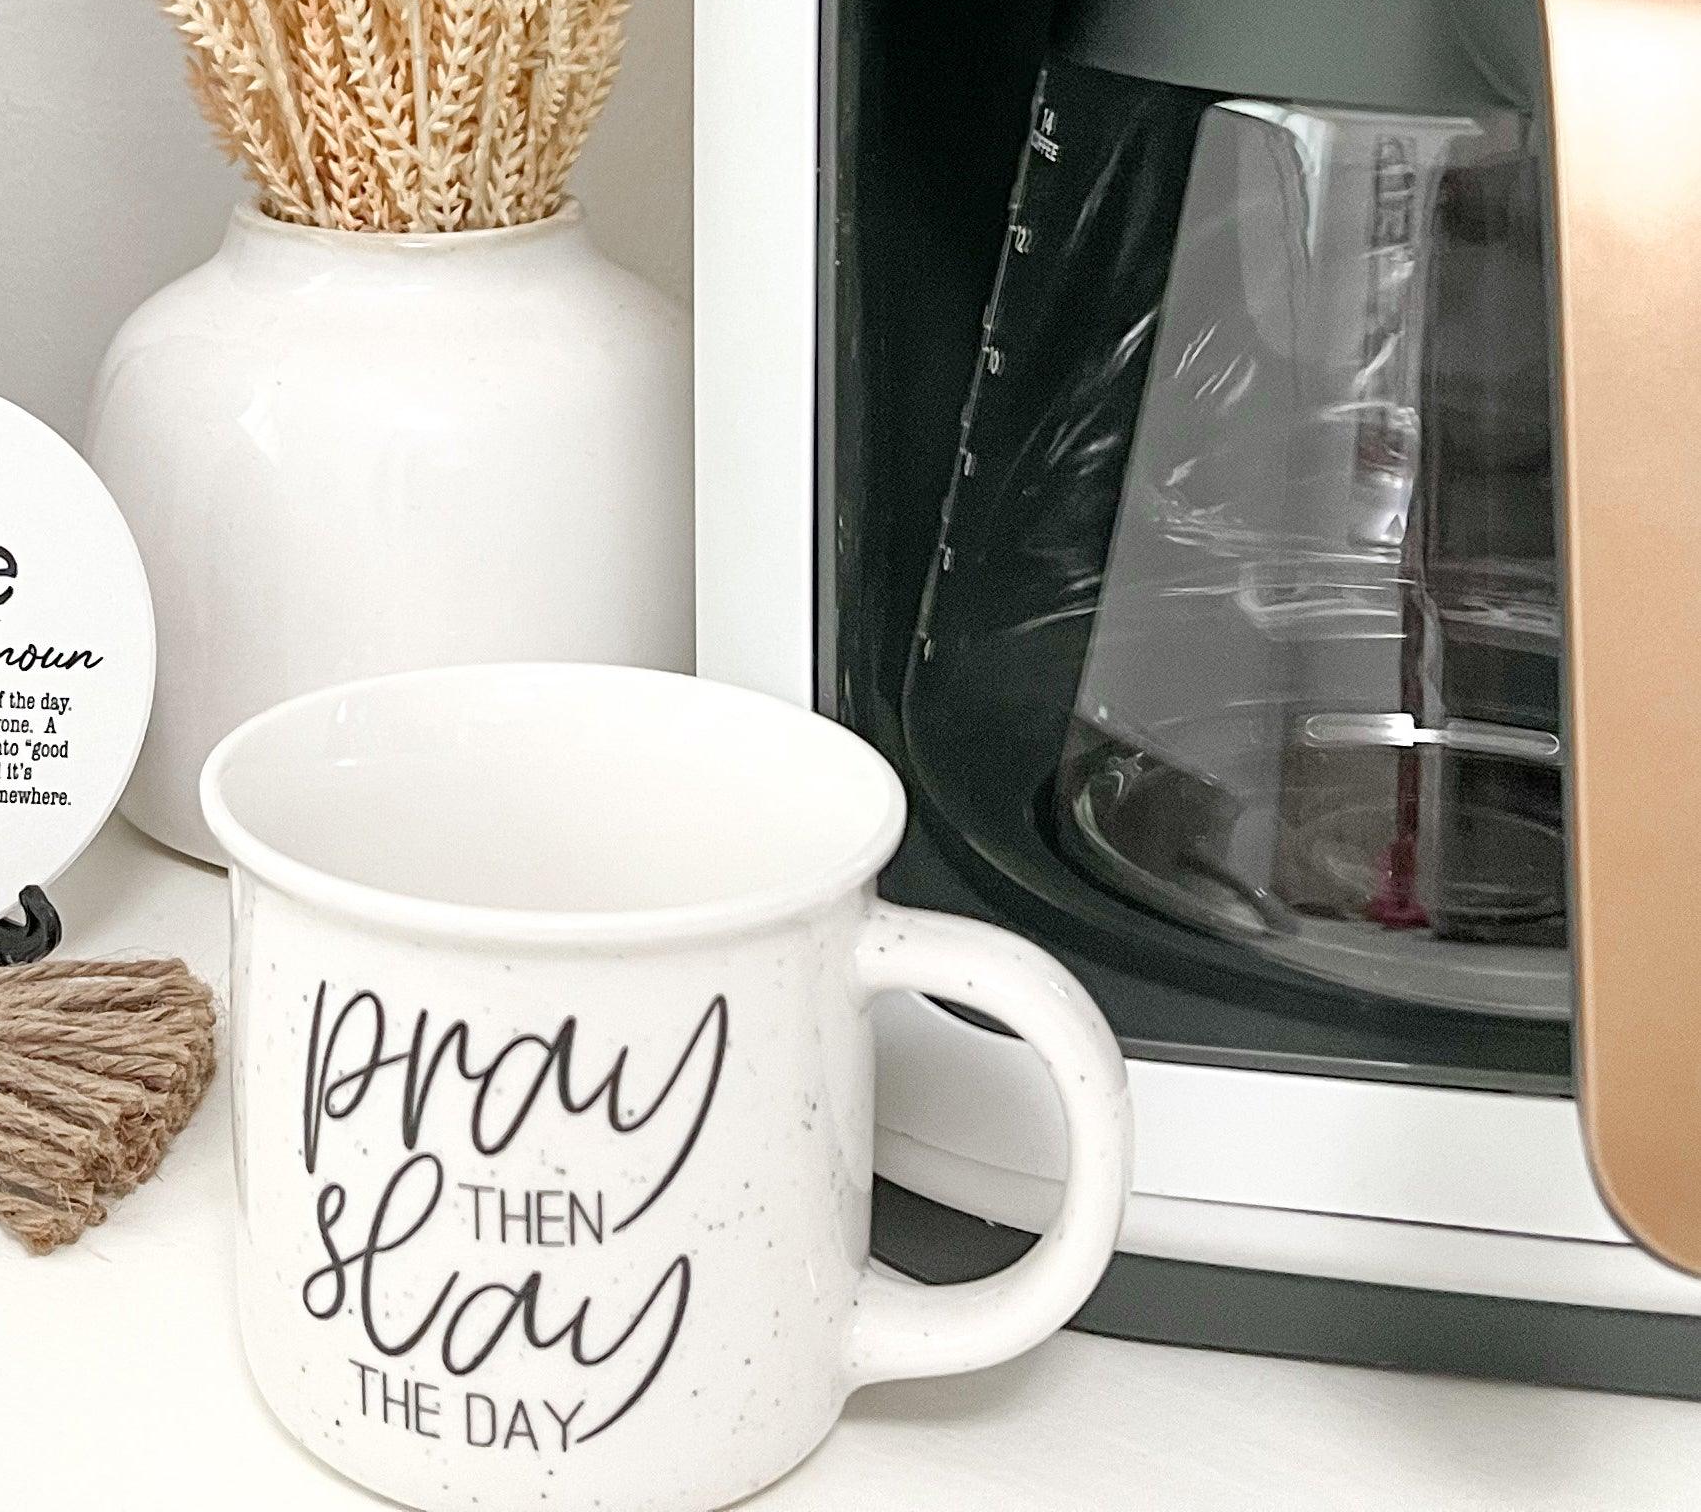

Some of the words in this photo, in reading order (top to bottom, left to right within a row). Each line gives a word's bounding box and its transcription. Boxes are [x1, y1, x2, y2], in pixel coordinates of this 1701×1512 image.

[9, 690, 36, 710] the
[40, 692, 72, 716] day.
[43, 715, 57, 735] A
[303, 979, 730, 1234] pray
[458, 1182, 605, 1247] THEN
[302, 1151, 691, 1445] slay
[348, 1358, 441, 1440] THE
[465, 1391, 586, 1453] DAY
